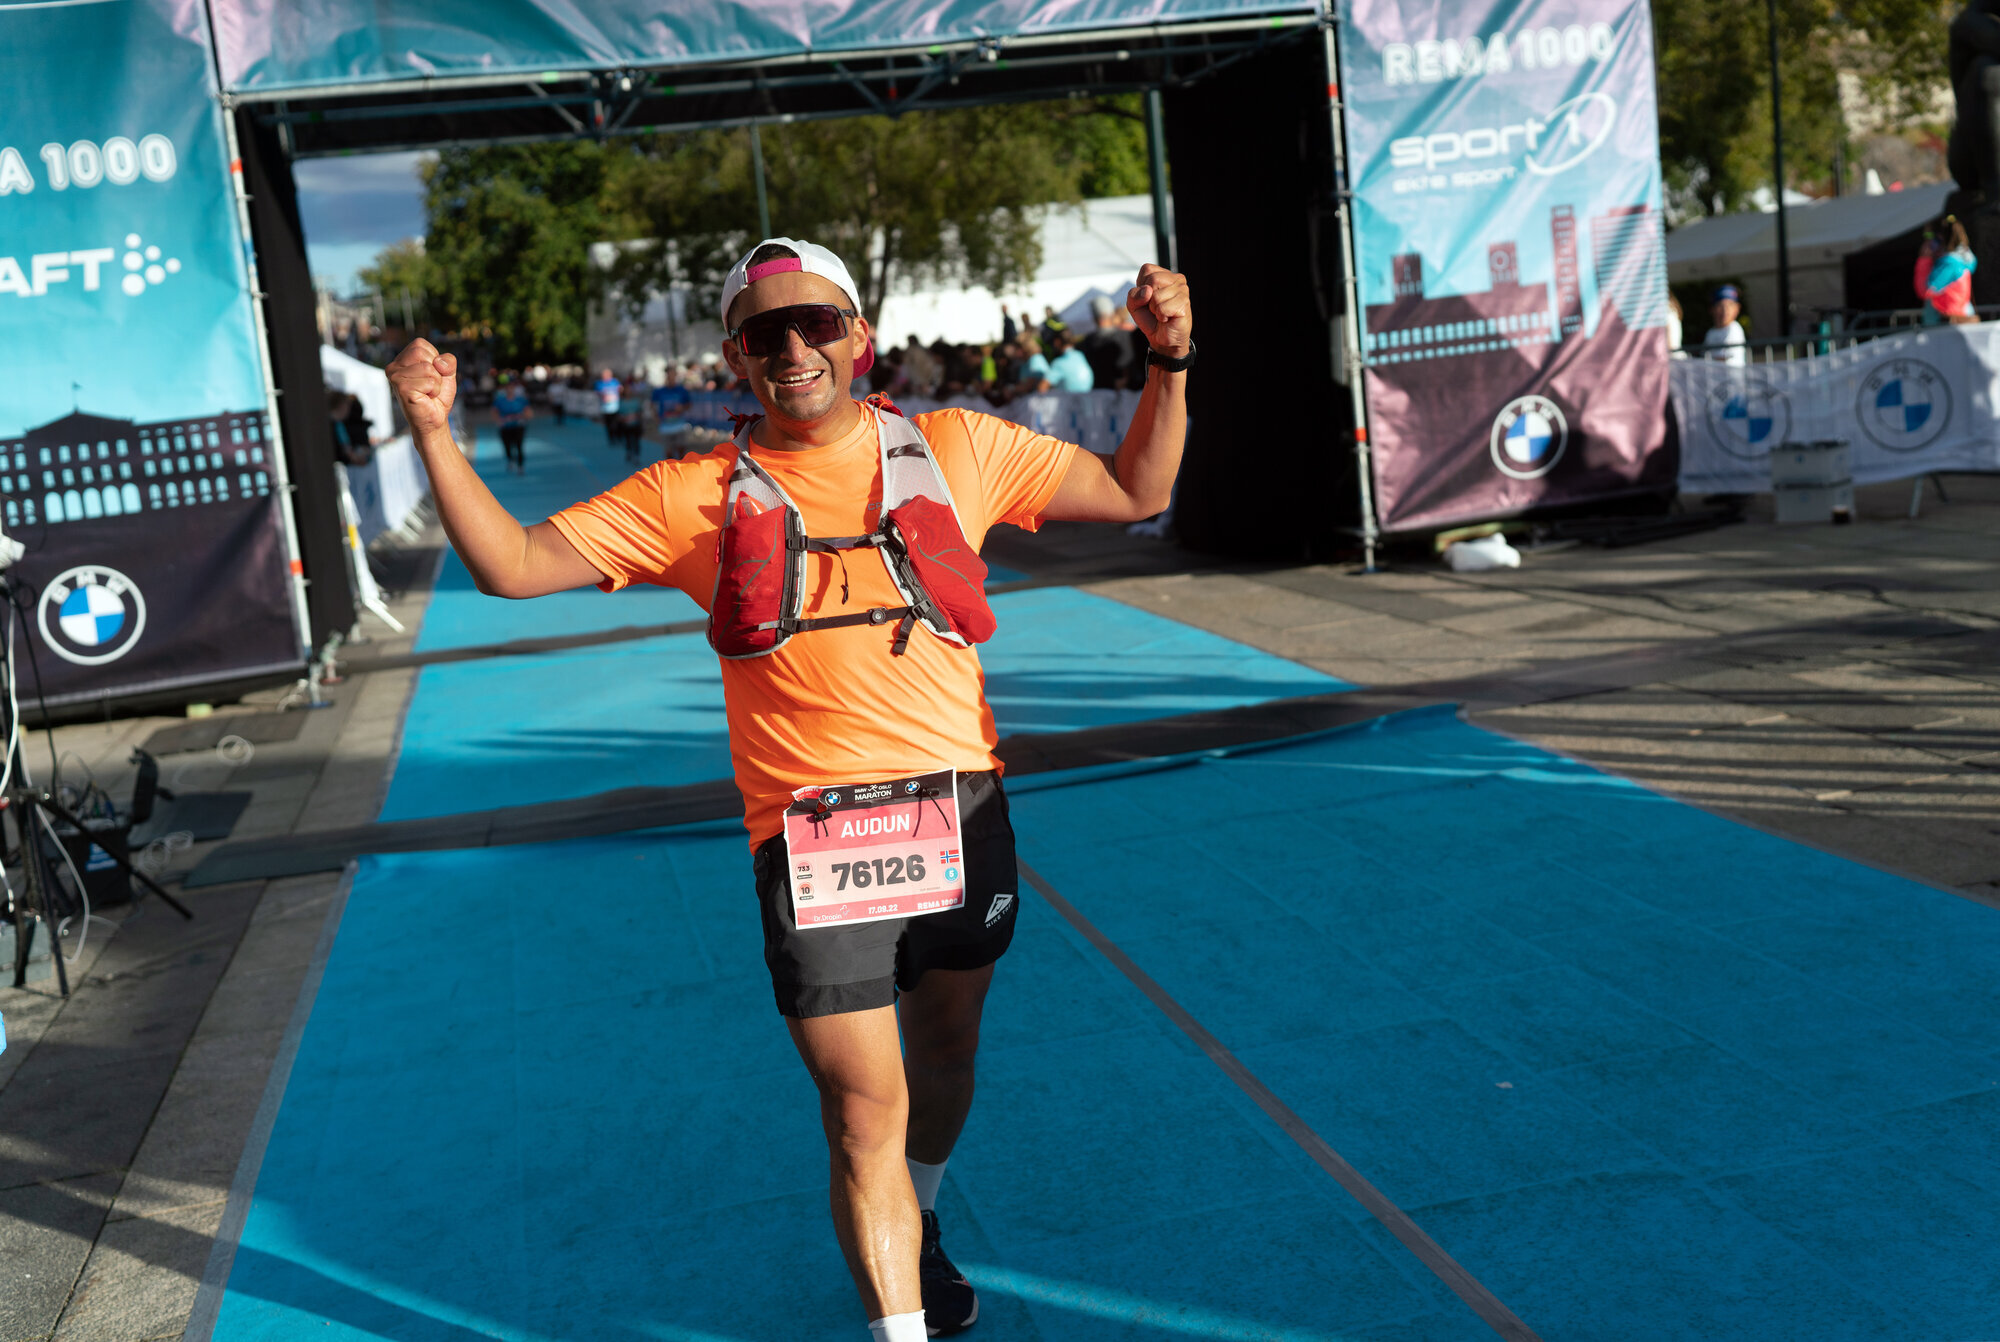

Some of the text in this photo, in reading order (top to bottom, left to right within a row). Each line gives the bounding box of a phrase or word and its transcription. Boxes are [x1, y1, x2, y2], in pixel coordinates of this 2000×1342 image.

[1383, 22, 1615, 86] REMA 1000
[1390, 116, 1547, 171] sport
[40, 133, 178, 191] 1000
[1392, 165, 1518, 194] ekte sport
[854, 790, 892, 801] MARATON
[840, 813, 910, 839] AUDUN
[831, 854, 926, 891] 76126
[948, 870, 955, 878] 5
[800, 886, 811, 895] 10
[868, 904, 898, 915] 17.09.22
[917, 898, 958, 910] REMA 1000
[985, 914, 1002, 929] NIKE
